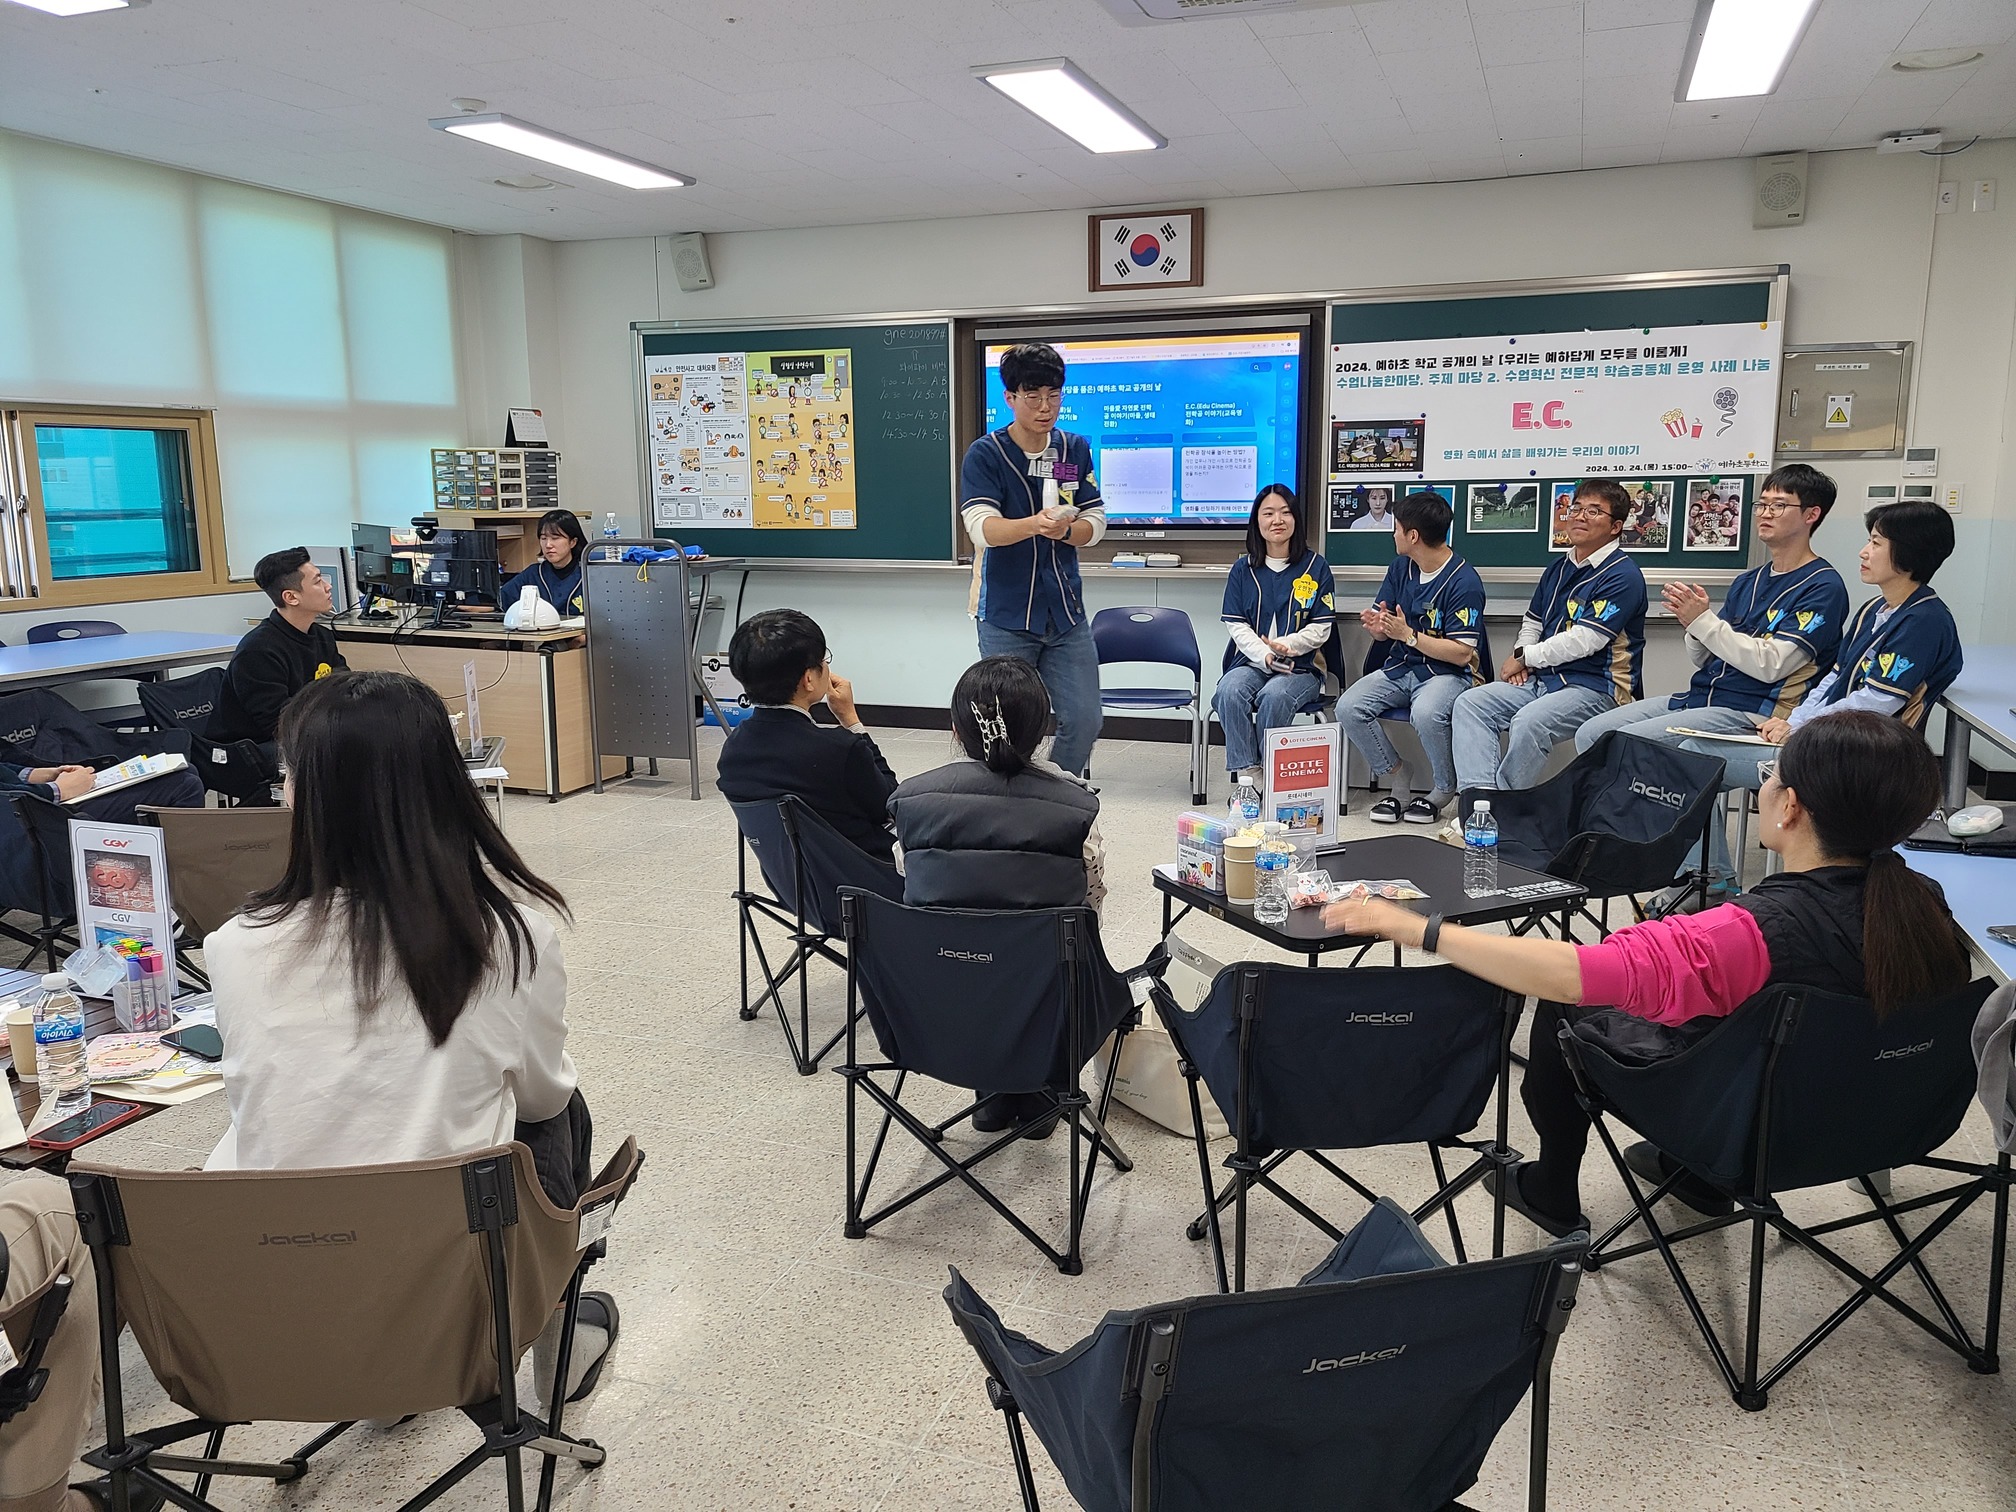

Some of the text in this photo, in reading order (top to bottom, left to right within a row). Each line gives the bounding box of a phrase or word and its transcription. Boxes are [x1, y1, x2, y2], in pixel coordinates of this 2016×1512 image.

[1335, 345, 1688, 373] 2024. 예하초 학교 공개의 날 [우리는 예하답게 모두를 이롭게]
[676, 365, 695, 373] 안전사고
[1337, 359, 1770, 389] 수업나눔한마당. 주제 마당 2. 수업혁신 전문적 학습공동체 운영 사례 나눔
[1118, 384, 1132, 392] 학교
[1155, 383, 1161, 391] 날
[1511, 400, 1573, 430] E.C.
[1443, 445, 1640, 460] 영화 속에서 삶을 배워가는 우리의 이야기
[1661, 463, 1693, 471] 15:00~
[1718, 459, 1769, 469] 예하초등학교
[174, 700, 214, 720] Jackal
[1, 724, 37, 743] ackal
[1279, 759, 1324, 771] LOTTE
[1279, 768, 1323, 778] CINEMA
[1287, 791, 1313, 800] 롯데시네마
[1628, 776, 1686, 808] Jackal
[103, 839, 128, 848] CGV
[92, 866, 141, 890] CGV
[111, 913, 131, 922] CGV
[937, 946, 994, 962] Jackal
[1346, 1011, 1414, 1024] Jackal
[1873, 1038, 1934, 1061] Jackal
[258, 1229, 358, 1247] Jackal
[1302, 1344, 1407, 1374] Jackal
